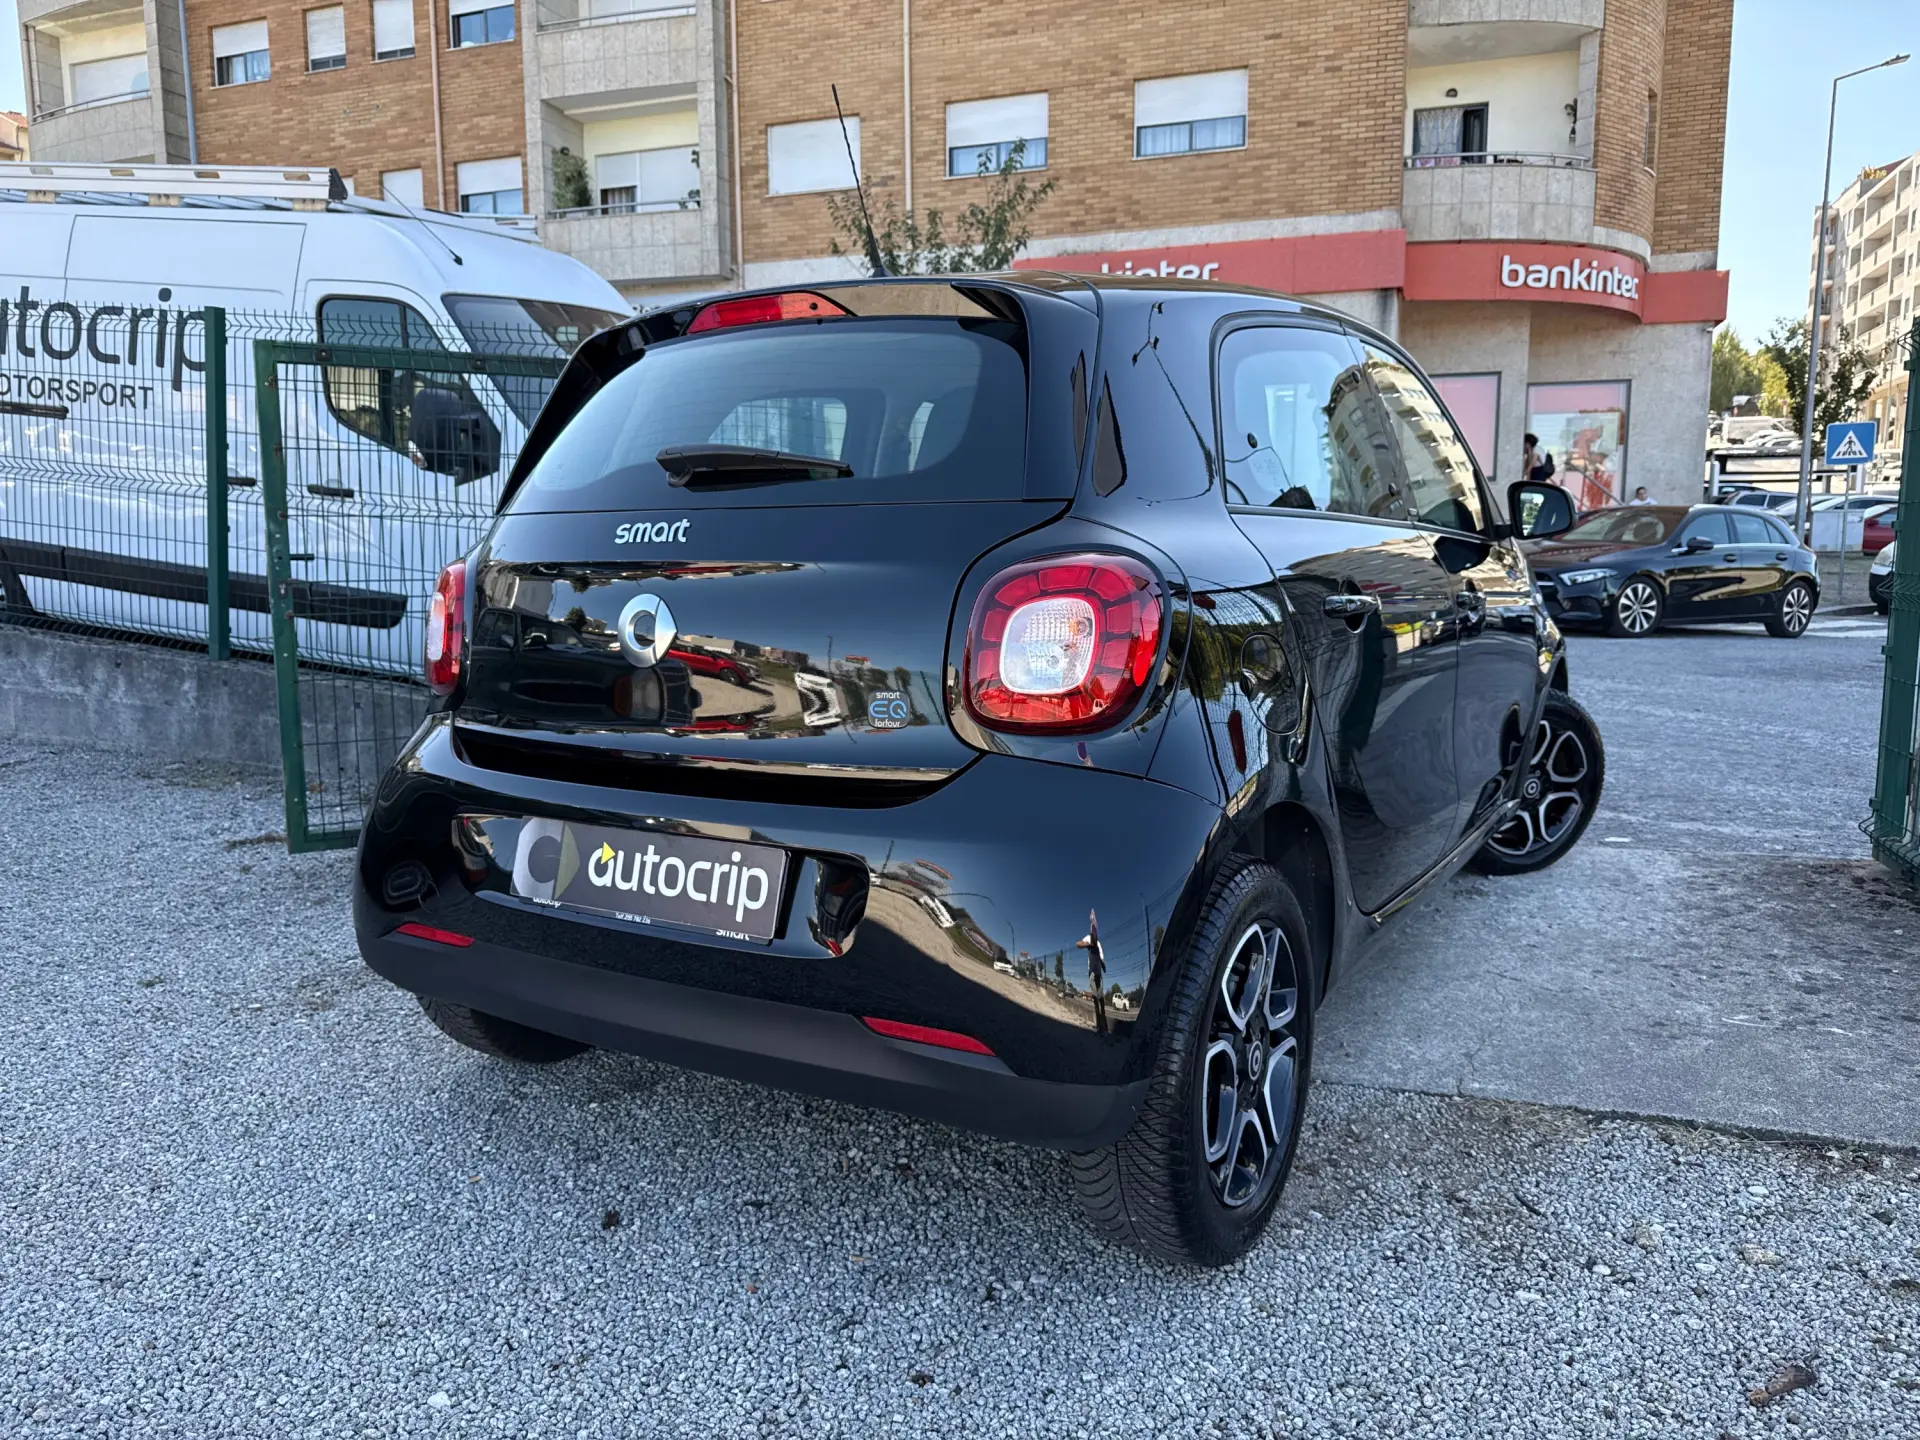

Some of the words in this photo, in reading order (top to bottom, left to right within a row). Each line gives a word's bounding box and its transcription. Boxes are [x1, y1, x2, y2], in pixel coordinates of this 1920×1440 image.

[614, 518, 690, 544] smart
[876, 691, 900, 699] smart
[870, 700, 907, 718] EQ
[587, 842, 769, 923] autocrip
